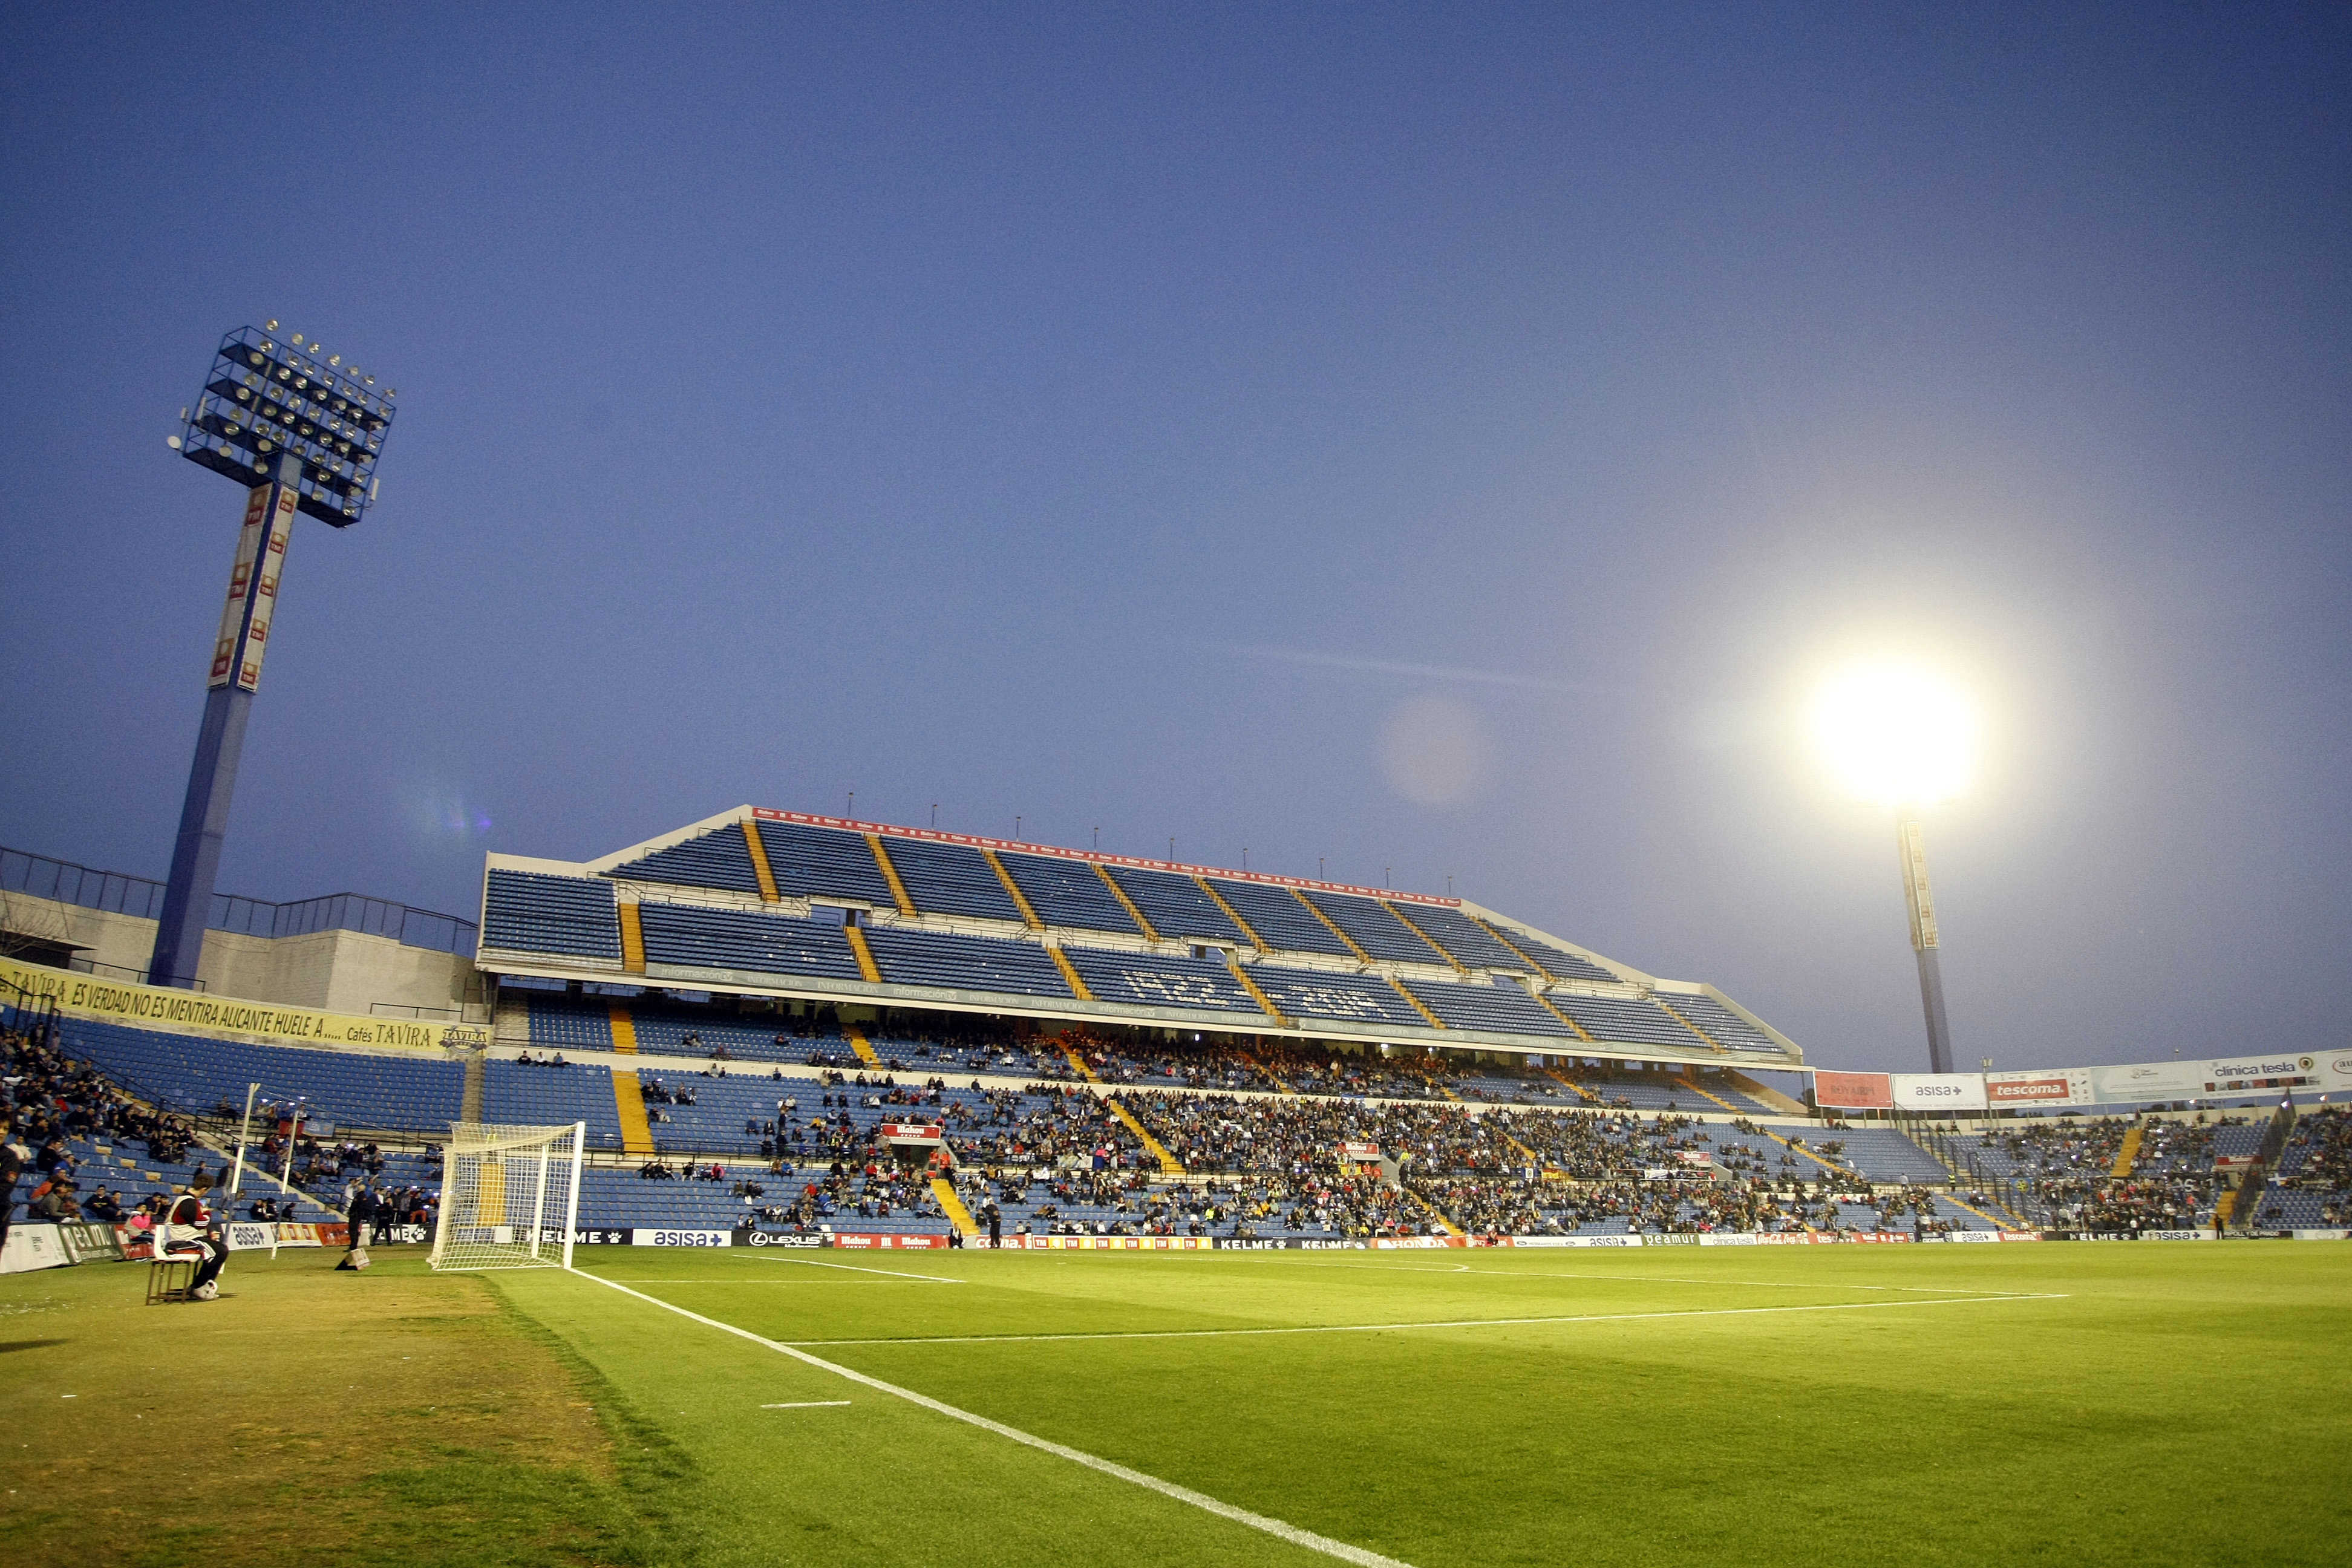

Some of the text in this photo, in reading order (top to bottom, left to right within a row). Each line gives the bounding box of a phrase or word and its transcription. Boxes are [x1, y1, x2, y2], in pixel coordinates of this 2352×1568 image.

[72, 982, 88, 1006] ES
[88, 985, 131, 1013] VERDAD
[130, 993, 151, 1016] NO
[151, 996, 167, 1018] ES
[166, 998, 219, 1025] MENTIRA
[218, 1005, 275, 1032] ALICANTE
[272, 1012, 312, 1037] HUELE
[347, 1027, 373, 1043] Cafés
[376, 1024, 431, 1047] TAVIRA
[443, 1030, 486, 1042] TAVIRA
[2215, 1062, 2296, 1077] clínica tesla
[1916, 1086, 1952, 1096] asisa
[897, 1125, 924, 1134] Mahou
[655, 1232, 707, 1247] asisa
[769, 1235, 820, 1245] LEXUS
[841, 1236, 871, 1245] Mahou
[901, 1237, 930, 1246] Mahou
[1392, 1239, 1449, 1249] HONDA
[1590, 1238, 1619, 1247] asisa
[1644, 1234, 1694, 1246] geamur
[1221, 1240, 1273, 1250] KELME
